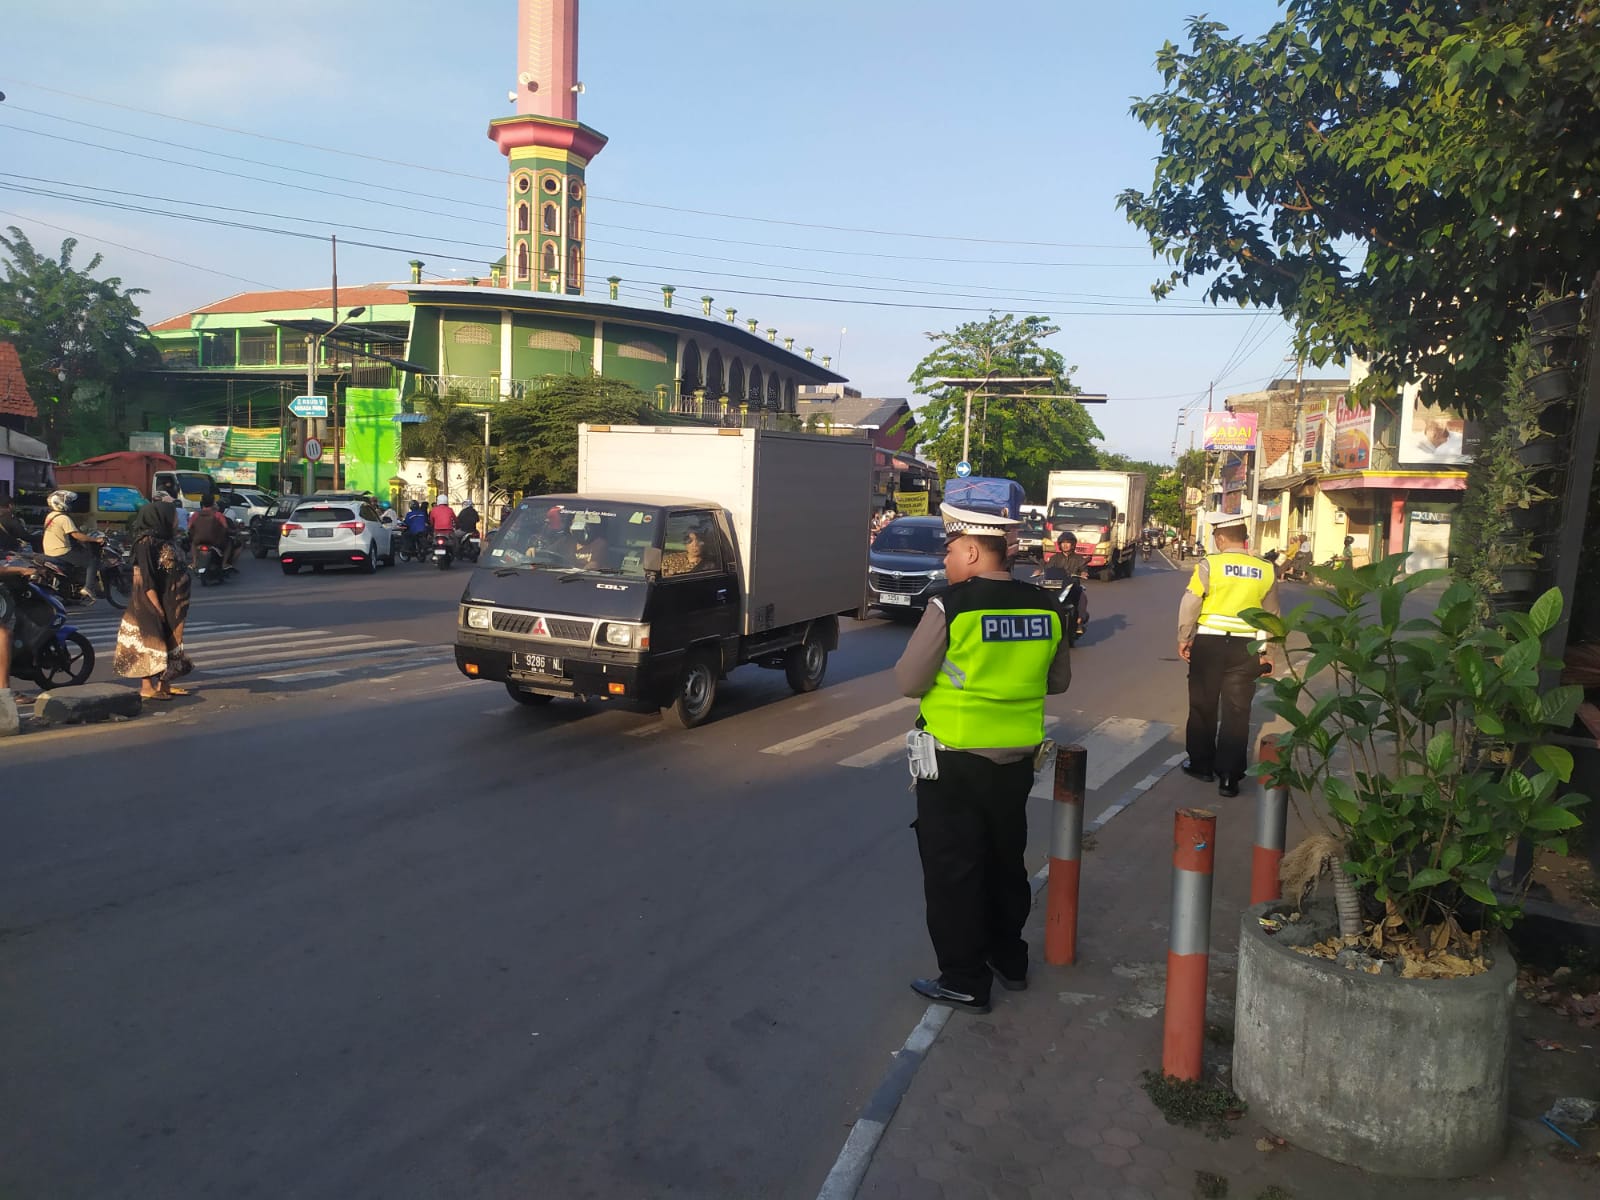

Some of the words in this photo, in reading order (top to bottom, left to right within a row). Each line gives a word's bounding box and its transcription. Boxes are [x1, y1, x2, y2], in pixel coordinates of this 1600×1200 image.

[1225, 564, 1262, 579] POLISI
[596, 583, 629, 591] COLT
[985, 617, 1049, 638] POLISI
[514, 652, 519, 664] L
[526, 655, 546, 668] 9286
[552, 658, 562, 671] NL
